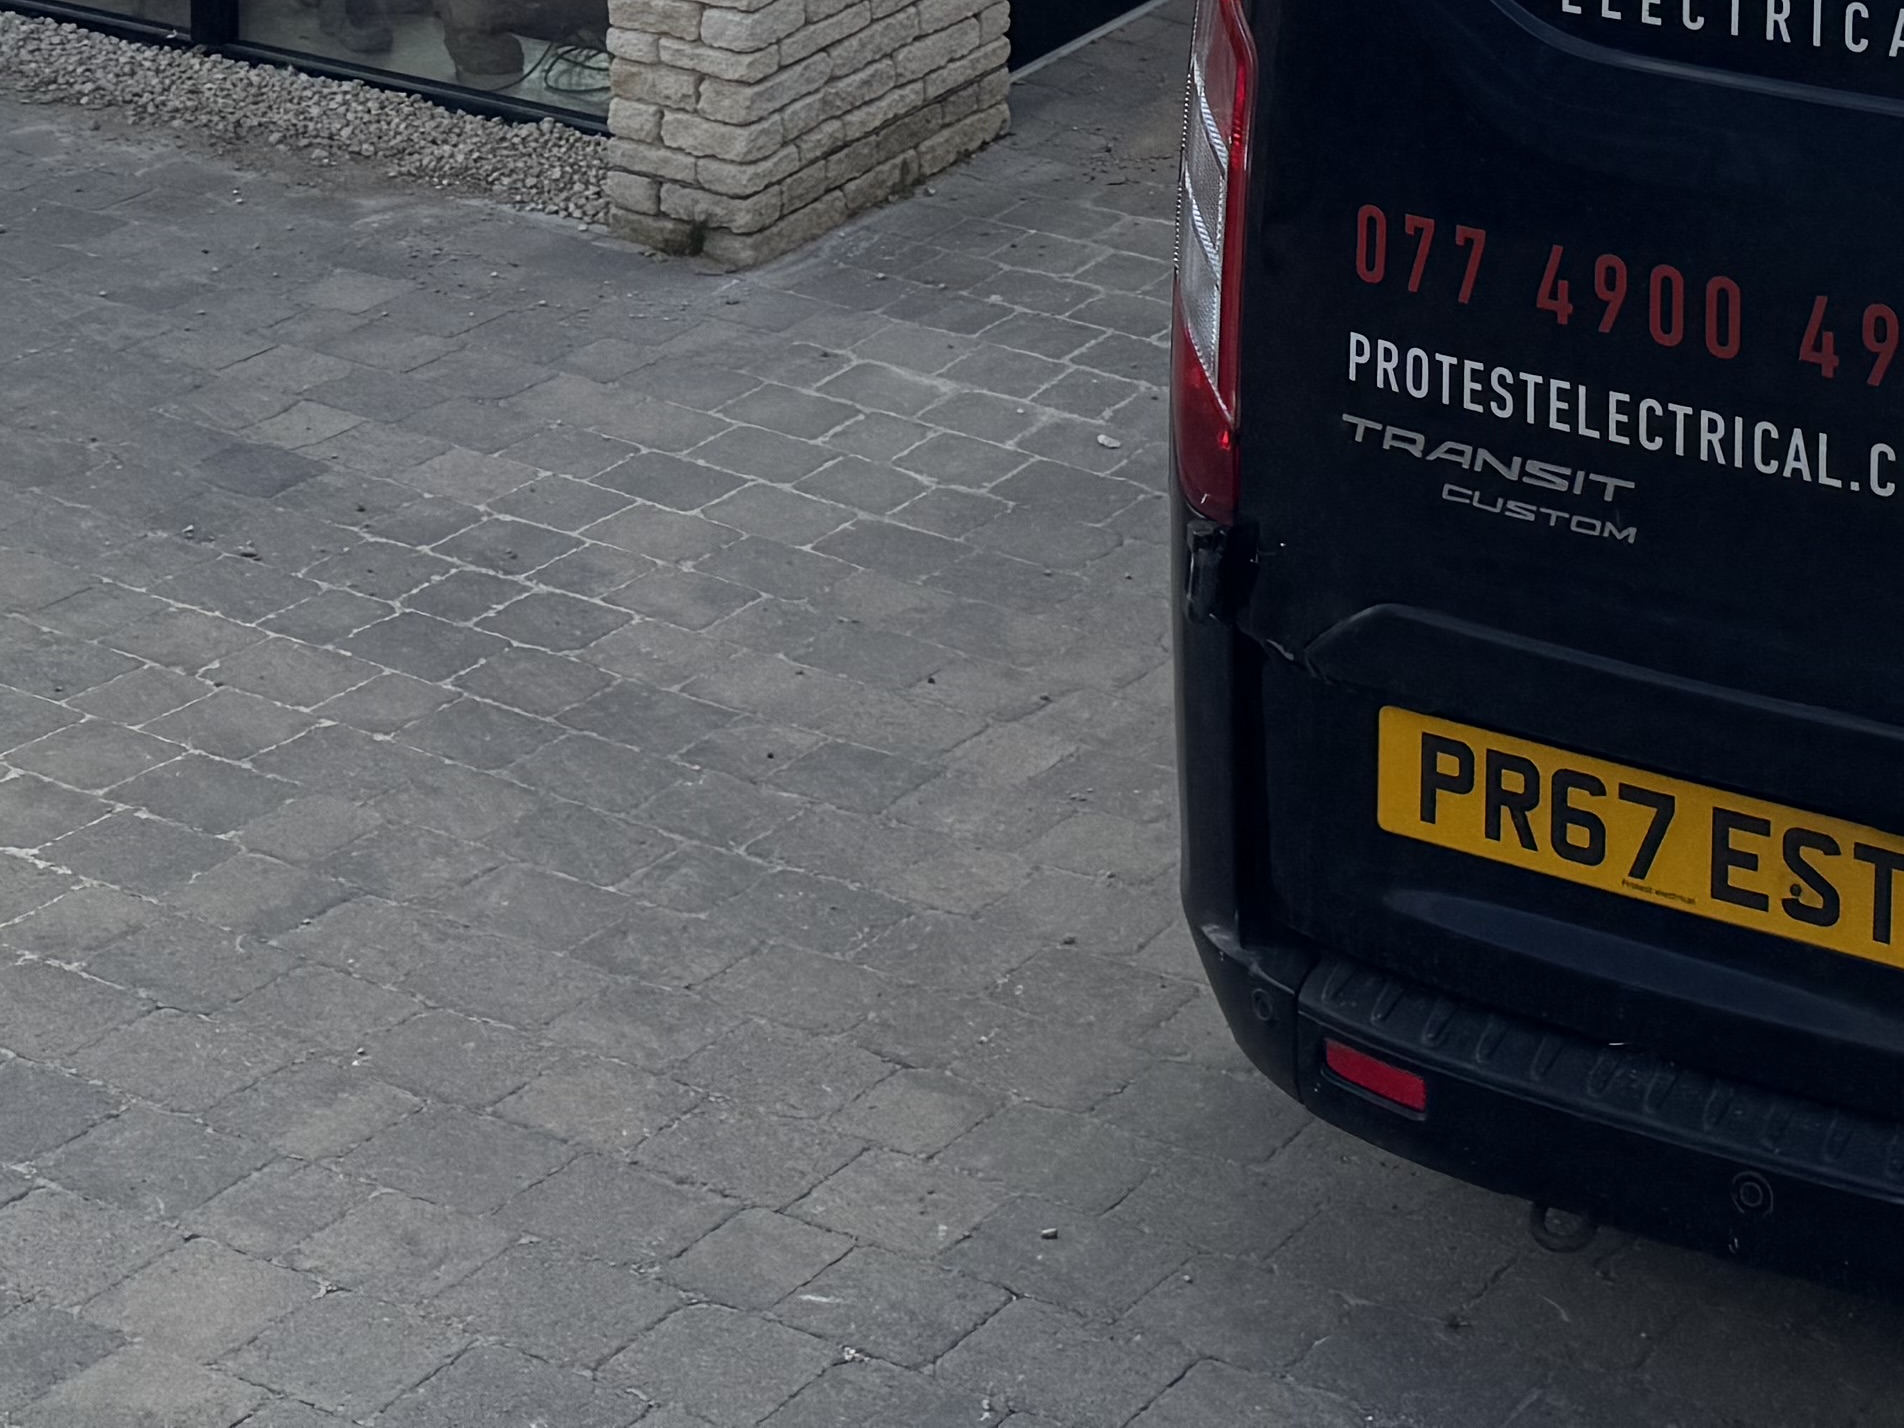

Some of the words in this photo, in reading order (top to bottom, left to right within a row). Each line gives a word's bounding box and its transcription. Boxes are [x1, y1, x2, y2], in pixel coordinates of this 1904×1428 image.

[1357, 206, 1485, 302] 077
[1538, 246, 1740, 359] 4900
[1343, 414, 1635, 501] TRANSIT
[1442, 484, 1637, 543] CUSTOM
[1421, 732, 1675, 880] PR67
